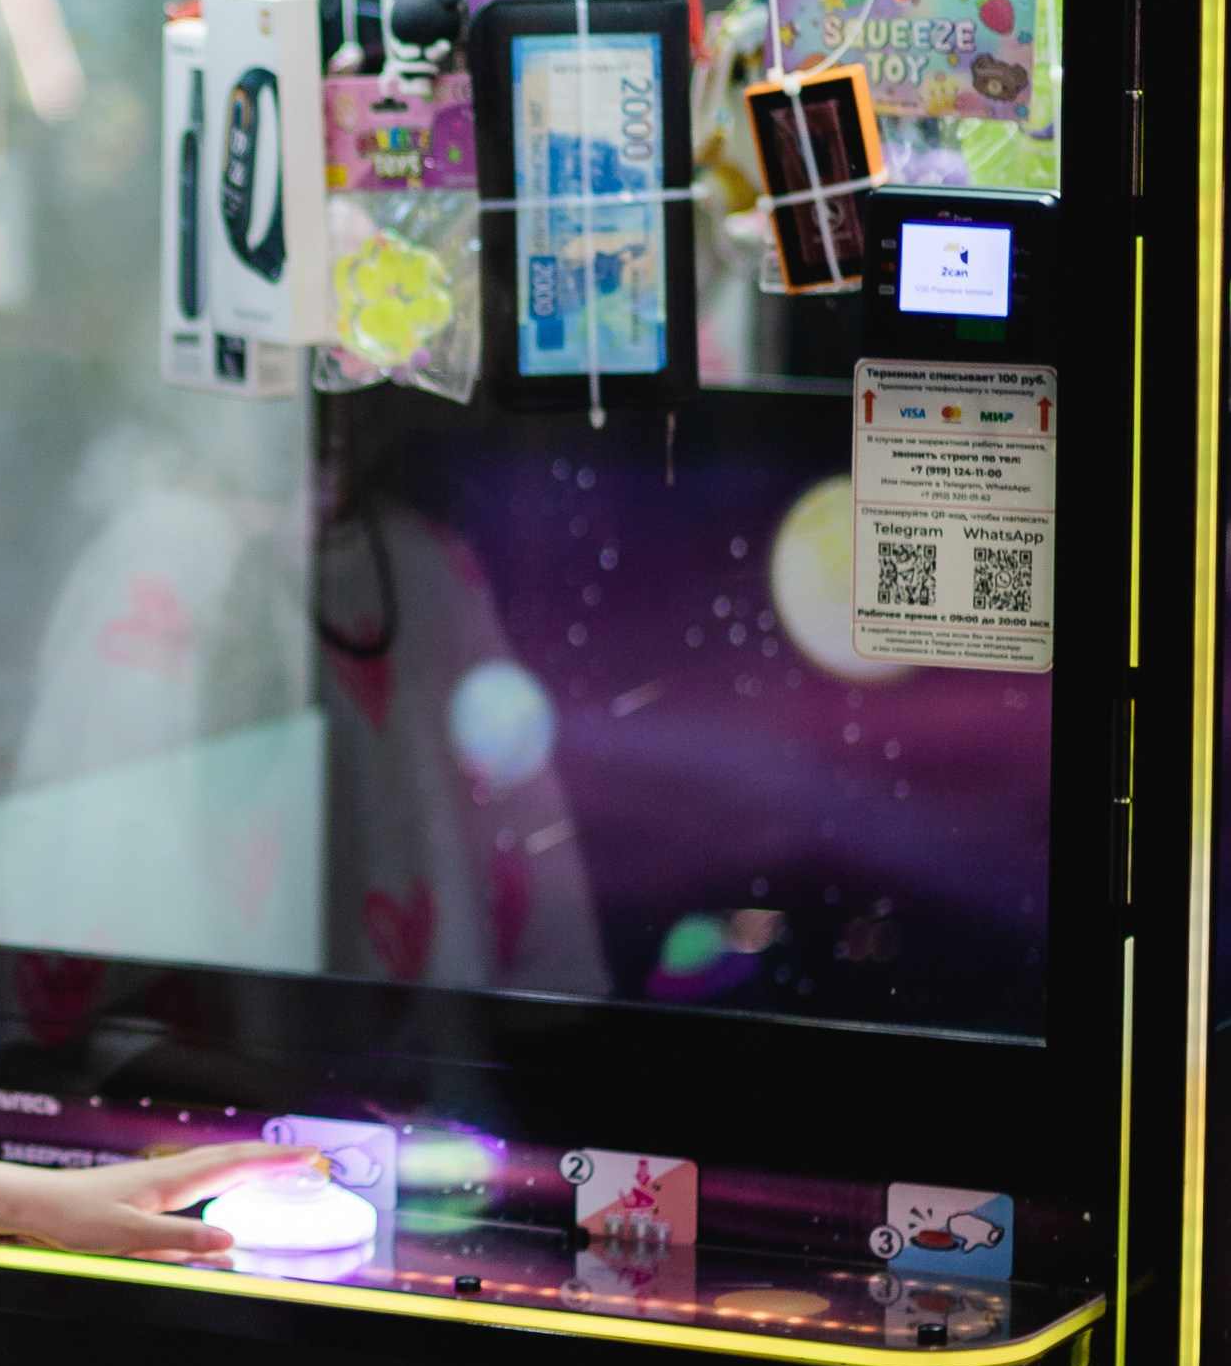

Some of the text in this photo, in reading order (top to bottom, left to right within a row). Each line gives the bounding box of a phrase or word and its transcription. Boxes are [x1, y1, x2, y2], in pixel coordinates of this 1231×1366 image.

[824, 14, 977, 53] SQUEEZE
[867, 50, 928, 85] TOY
[621, 75, 654, 161] 2000
[942, 267, 968, 277] 2can
[866, 368, 1047, 387] Терминал списывает 100 руб.
[899, 407, 926, 419] VISA
[980, 411, 1014, 423] МИР
[972, 441, 1003, 450] работы
[940, 453, 978, 463] строго
[981, 455, 995, 463] по
[911, 466, 922, 474] +7
[954, 467, 1002, 478] 124-11-00
[873, 522, 943, 537] Telegram
[963, 527, 1044, 545] WhatsApp
[949, 614, 978, 624] 09:00
[981, 616, 995, 626] до
[568, 1155, 585, 1180] 2
[878, 1229, 894, 1254] 3
